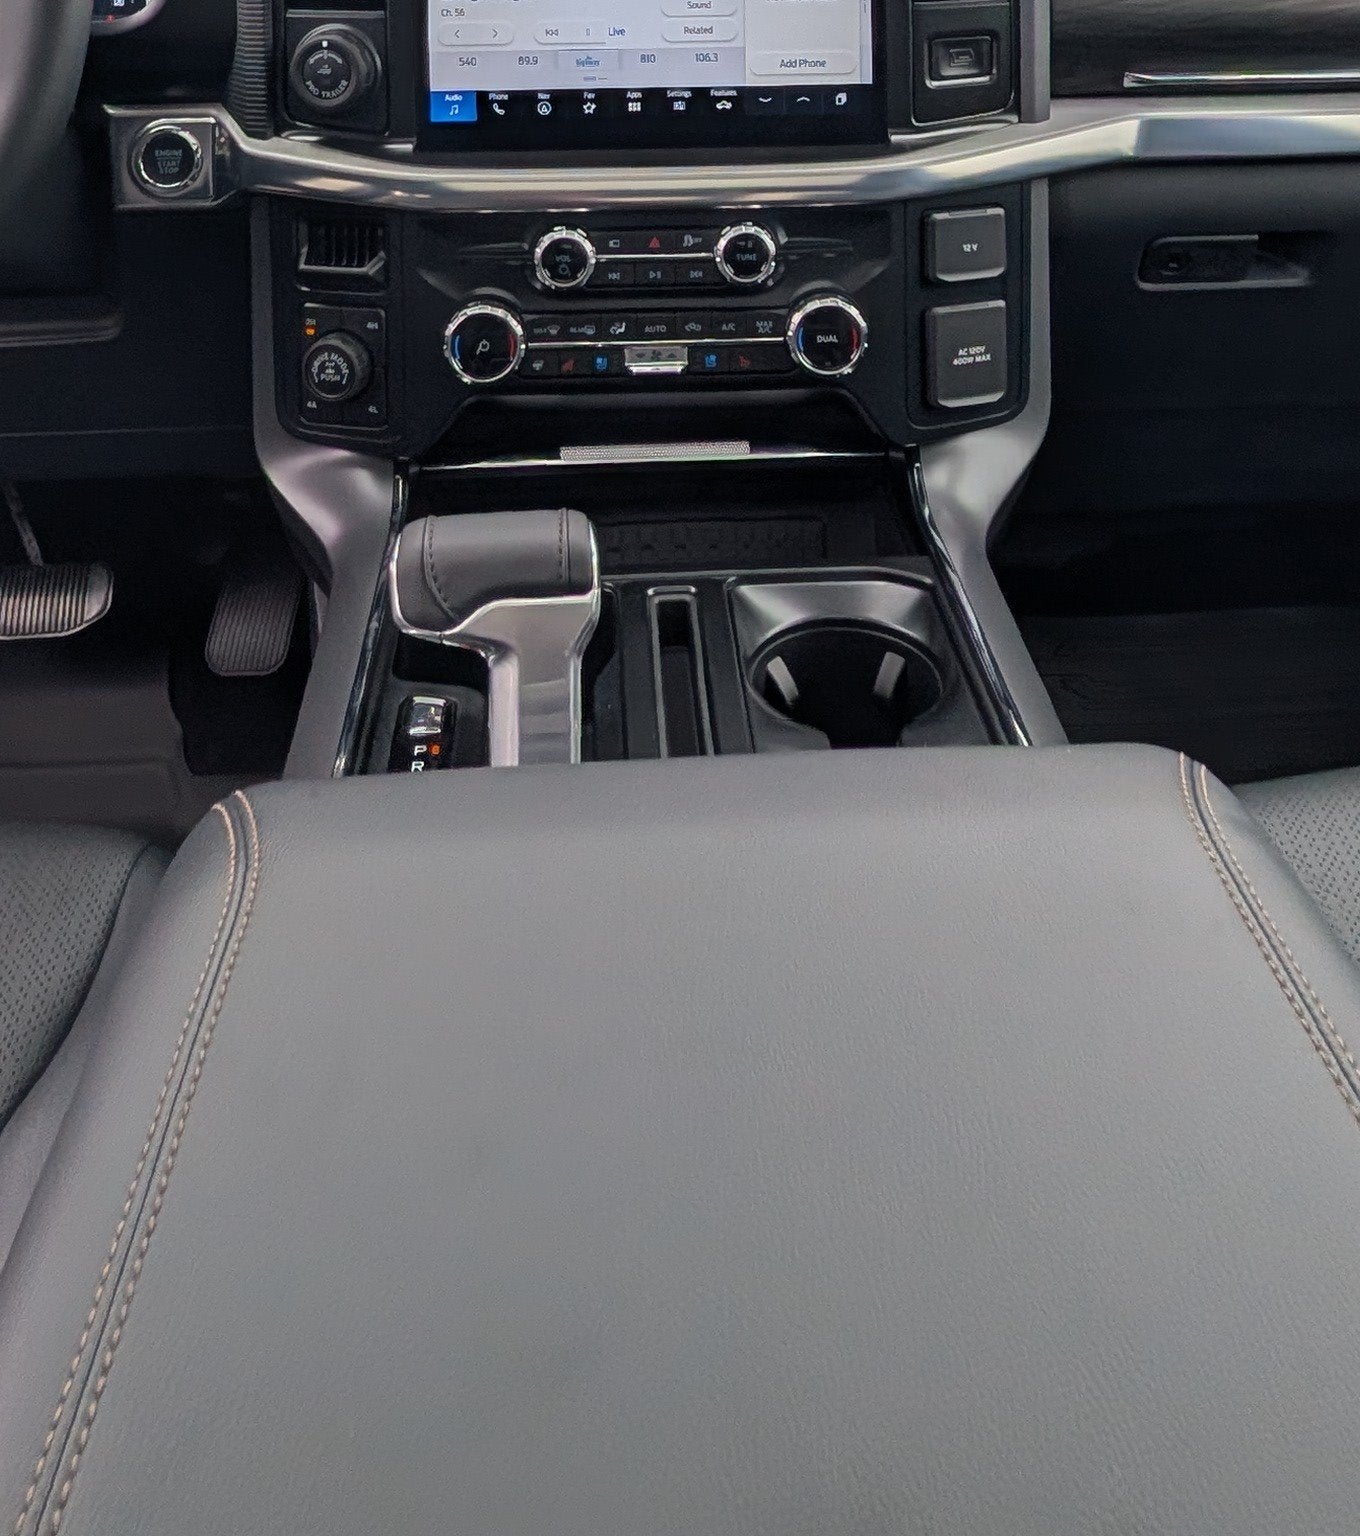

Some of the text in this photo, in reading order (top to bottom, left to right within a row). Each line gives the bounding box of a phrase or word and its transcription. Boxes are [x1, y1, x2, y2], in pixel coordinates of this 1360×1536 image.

[687, 0, 712, 10] Sound
[454, 8, 465, 17] 56
[608, 26, 627, 37] Live
[683, 26, 714, 35] Related
[458, 57, 477, 66] 540
[517, 56, 539, 65] 89.9
[640, 54, 656, 63] 810
[695, 52, 719, 62] 106.3
[779, 58, 827, 68] Add Phone
[305, 80, 349, 99] PRO TRAILER
[666, 89, 692, 99] Settings
[710, 89, 738, 97] Features
[444, 93, 463, 102] Audio
[488, 93, 509, 101] Phone
[626, 91, 643, 100] Apps
[644, 325, 667, 334] AUTO
[721, 323, 736, 332] A/C
[816, 335, 839, 344] DUAL
[975, 353, 991, 363] MAX
[320, 373, 340, 382] PUSH
[414, 745, 427, 756] P
[411, 761, 425, 773] R
